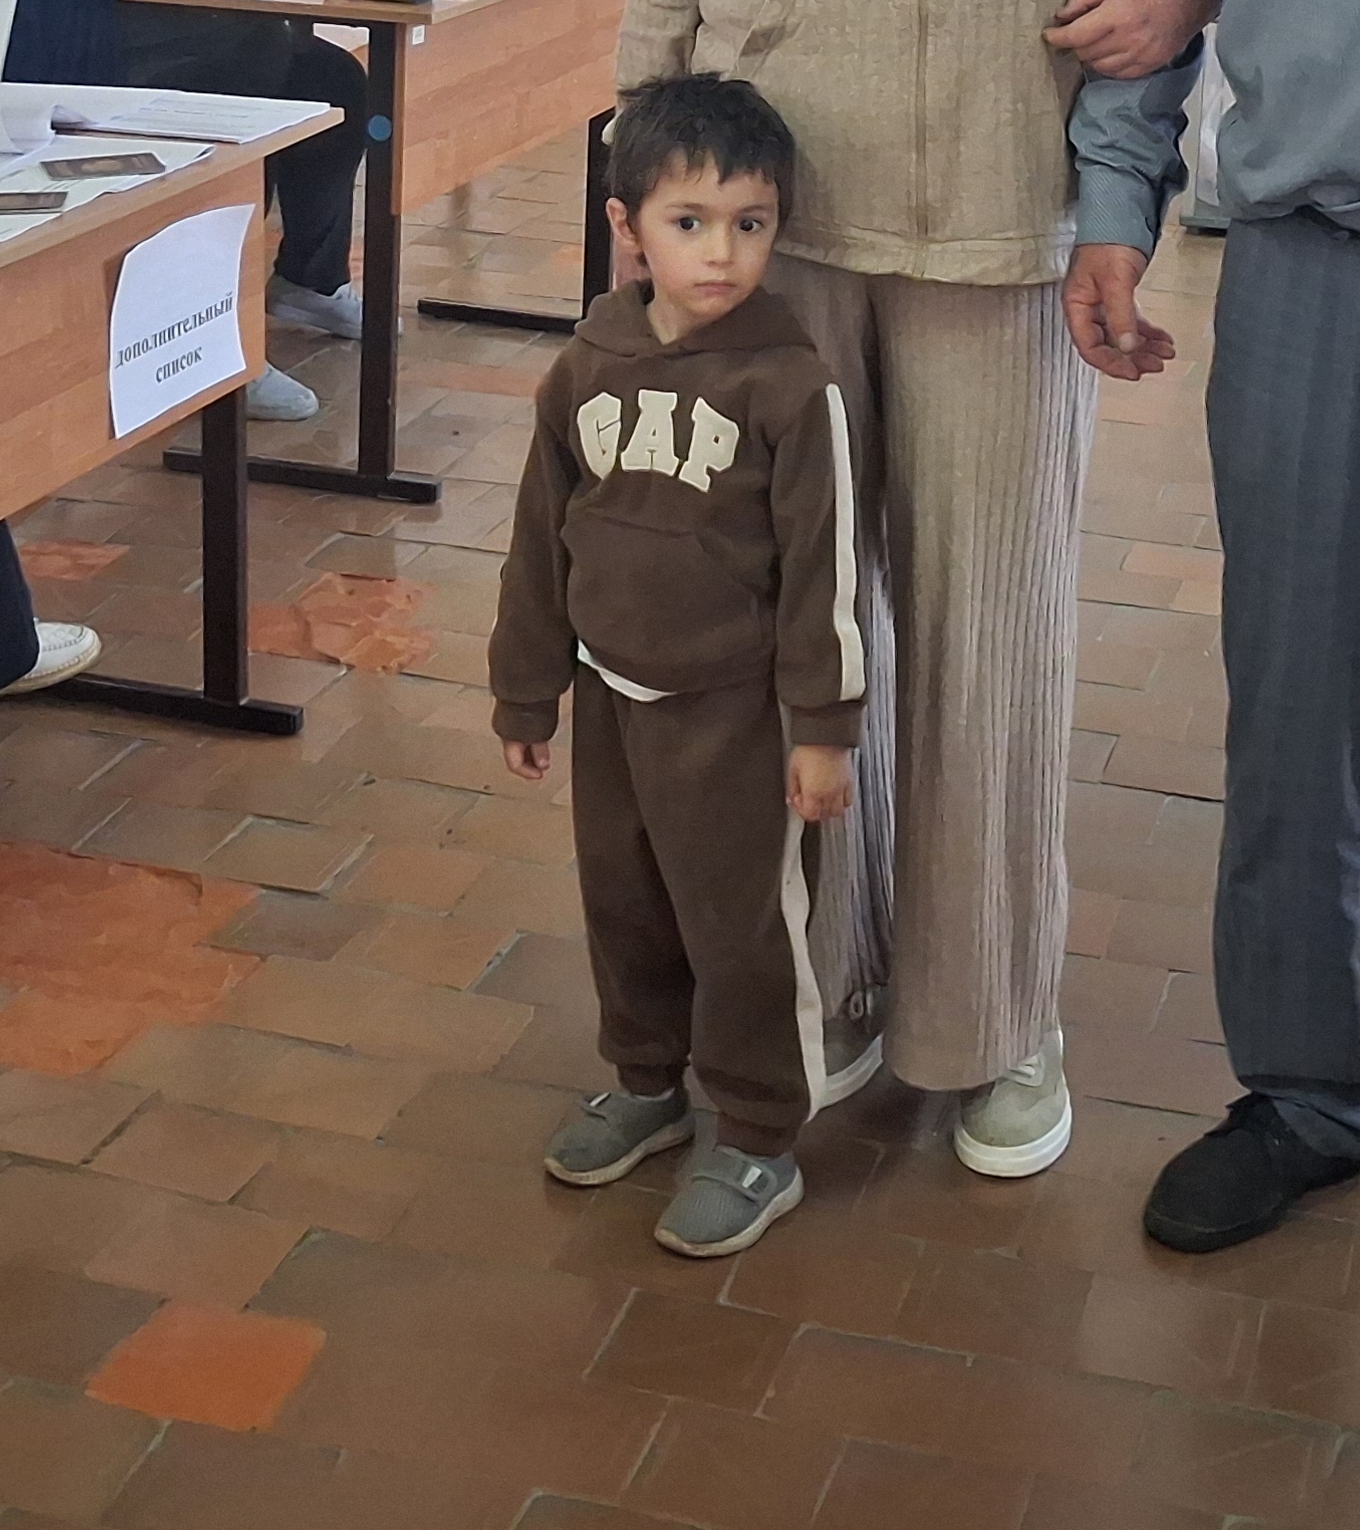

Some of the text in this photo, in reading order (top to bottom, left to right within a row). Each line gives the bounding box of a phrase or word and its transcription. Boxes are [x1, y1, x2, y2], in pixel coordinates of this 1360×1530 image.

[115, 290, 234, 370] дополнительный
[154, 345, 203, 385] список
[577, 388, 740, 493] GAP
